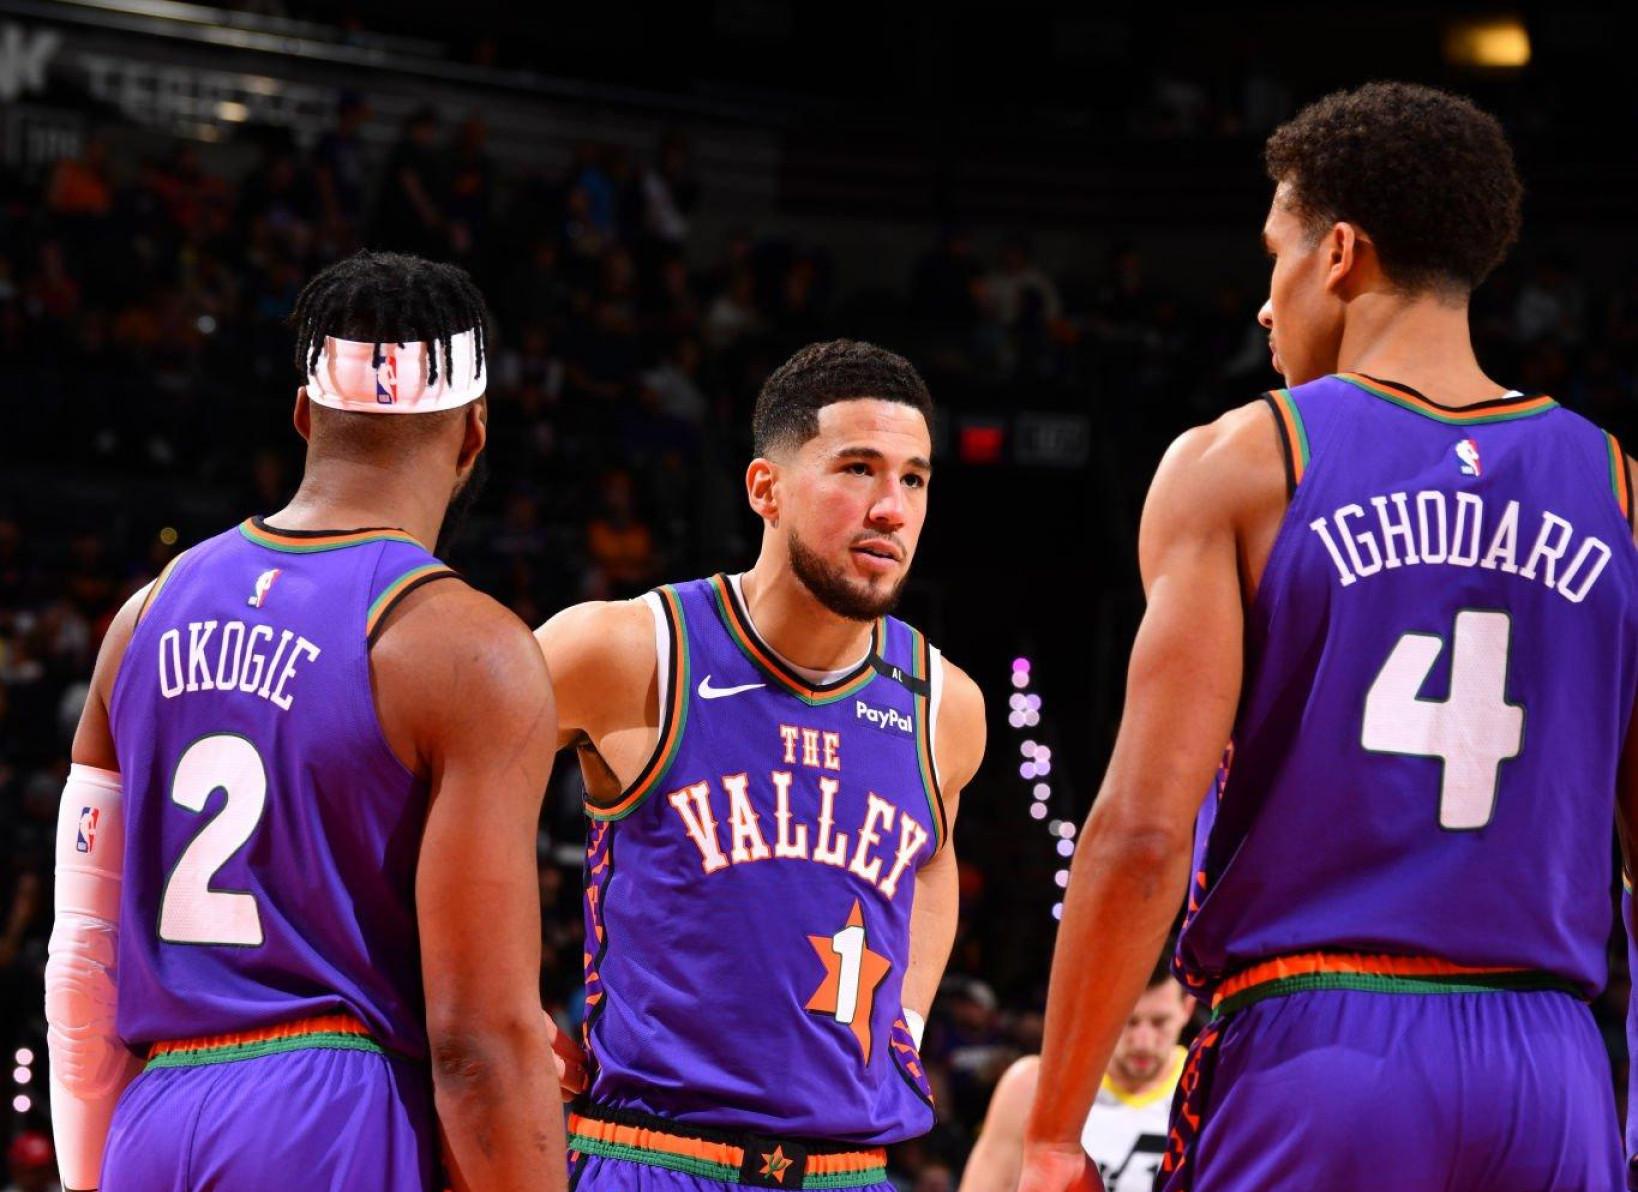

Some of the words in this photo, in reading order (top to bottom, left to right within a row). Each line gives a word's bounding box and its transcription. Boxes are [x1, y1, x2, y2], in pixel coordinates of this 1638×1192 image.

[1310, 489, 1612, 604] IGHODARO
[159, 620, 321, 711] OKOGIE
[892, 667, 903, 682] AL
[780, 724, 841, 771] THE
[856, 700, 913, 733] PayPal
[1360, 608, 1526, 829] 4
[157, 732, 267, 947] 2
[668, 771, 929, 901] VALLEY
[832, 924, 865, 1025] 1
